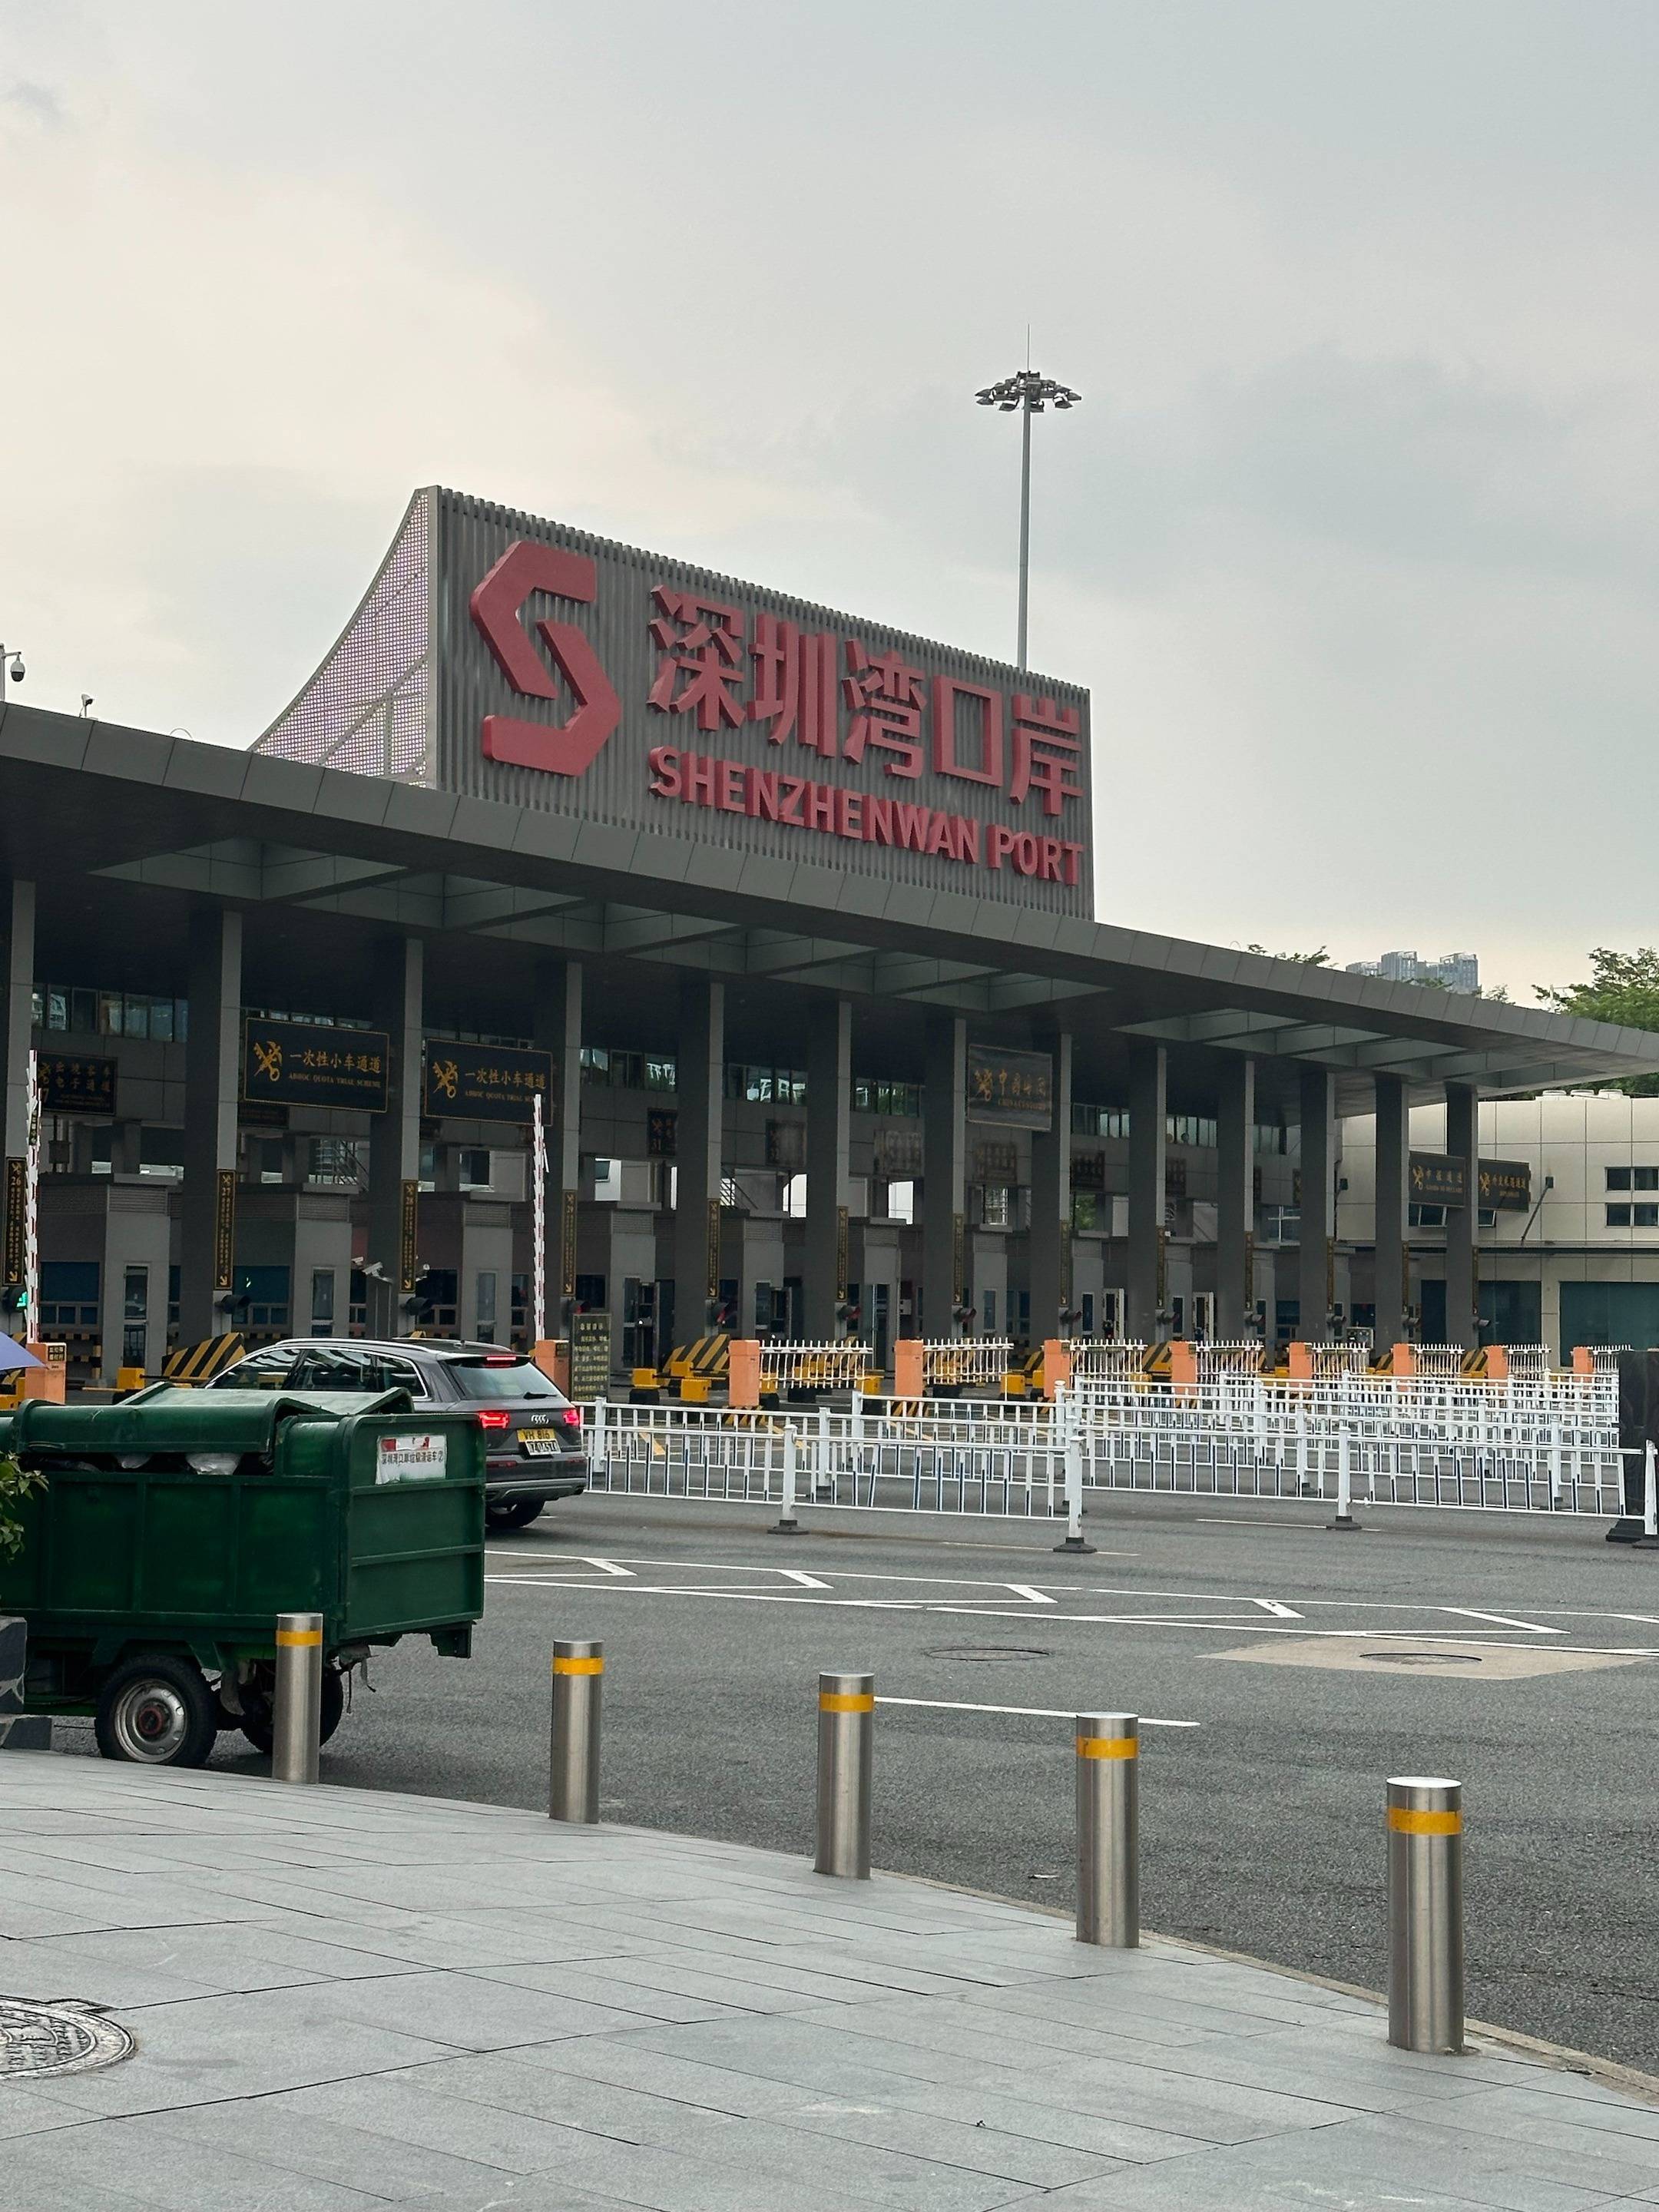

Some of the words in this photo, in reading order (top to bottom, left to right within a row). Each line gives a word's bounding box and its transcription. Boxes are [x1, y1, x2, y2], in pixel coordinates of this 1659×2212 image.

[646, 584, 1083, 816] 深圳湾口岸
[649, 746, 979, 864] SHENZHENWAN
[987, 823, 1084, 885] PORT
[290, 1049, 381, 1074] 一次性小车通道
[465, 1068, 546, 1090] 一次性小车通道
[12, 1176, 22, 1185] 26
[221, 1187, 230, 1196] 27
